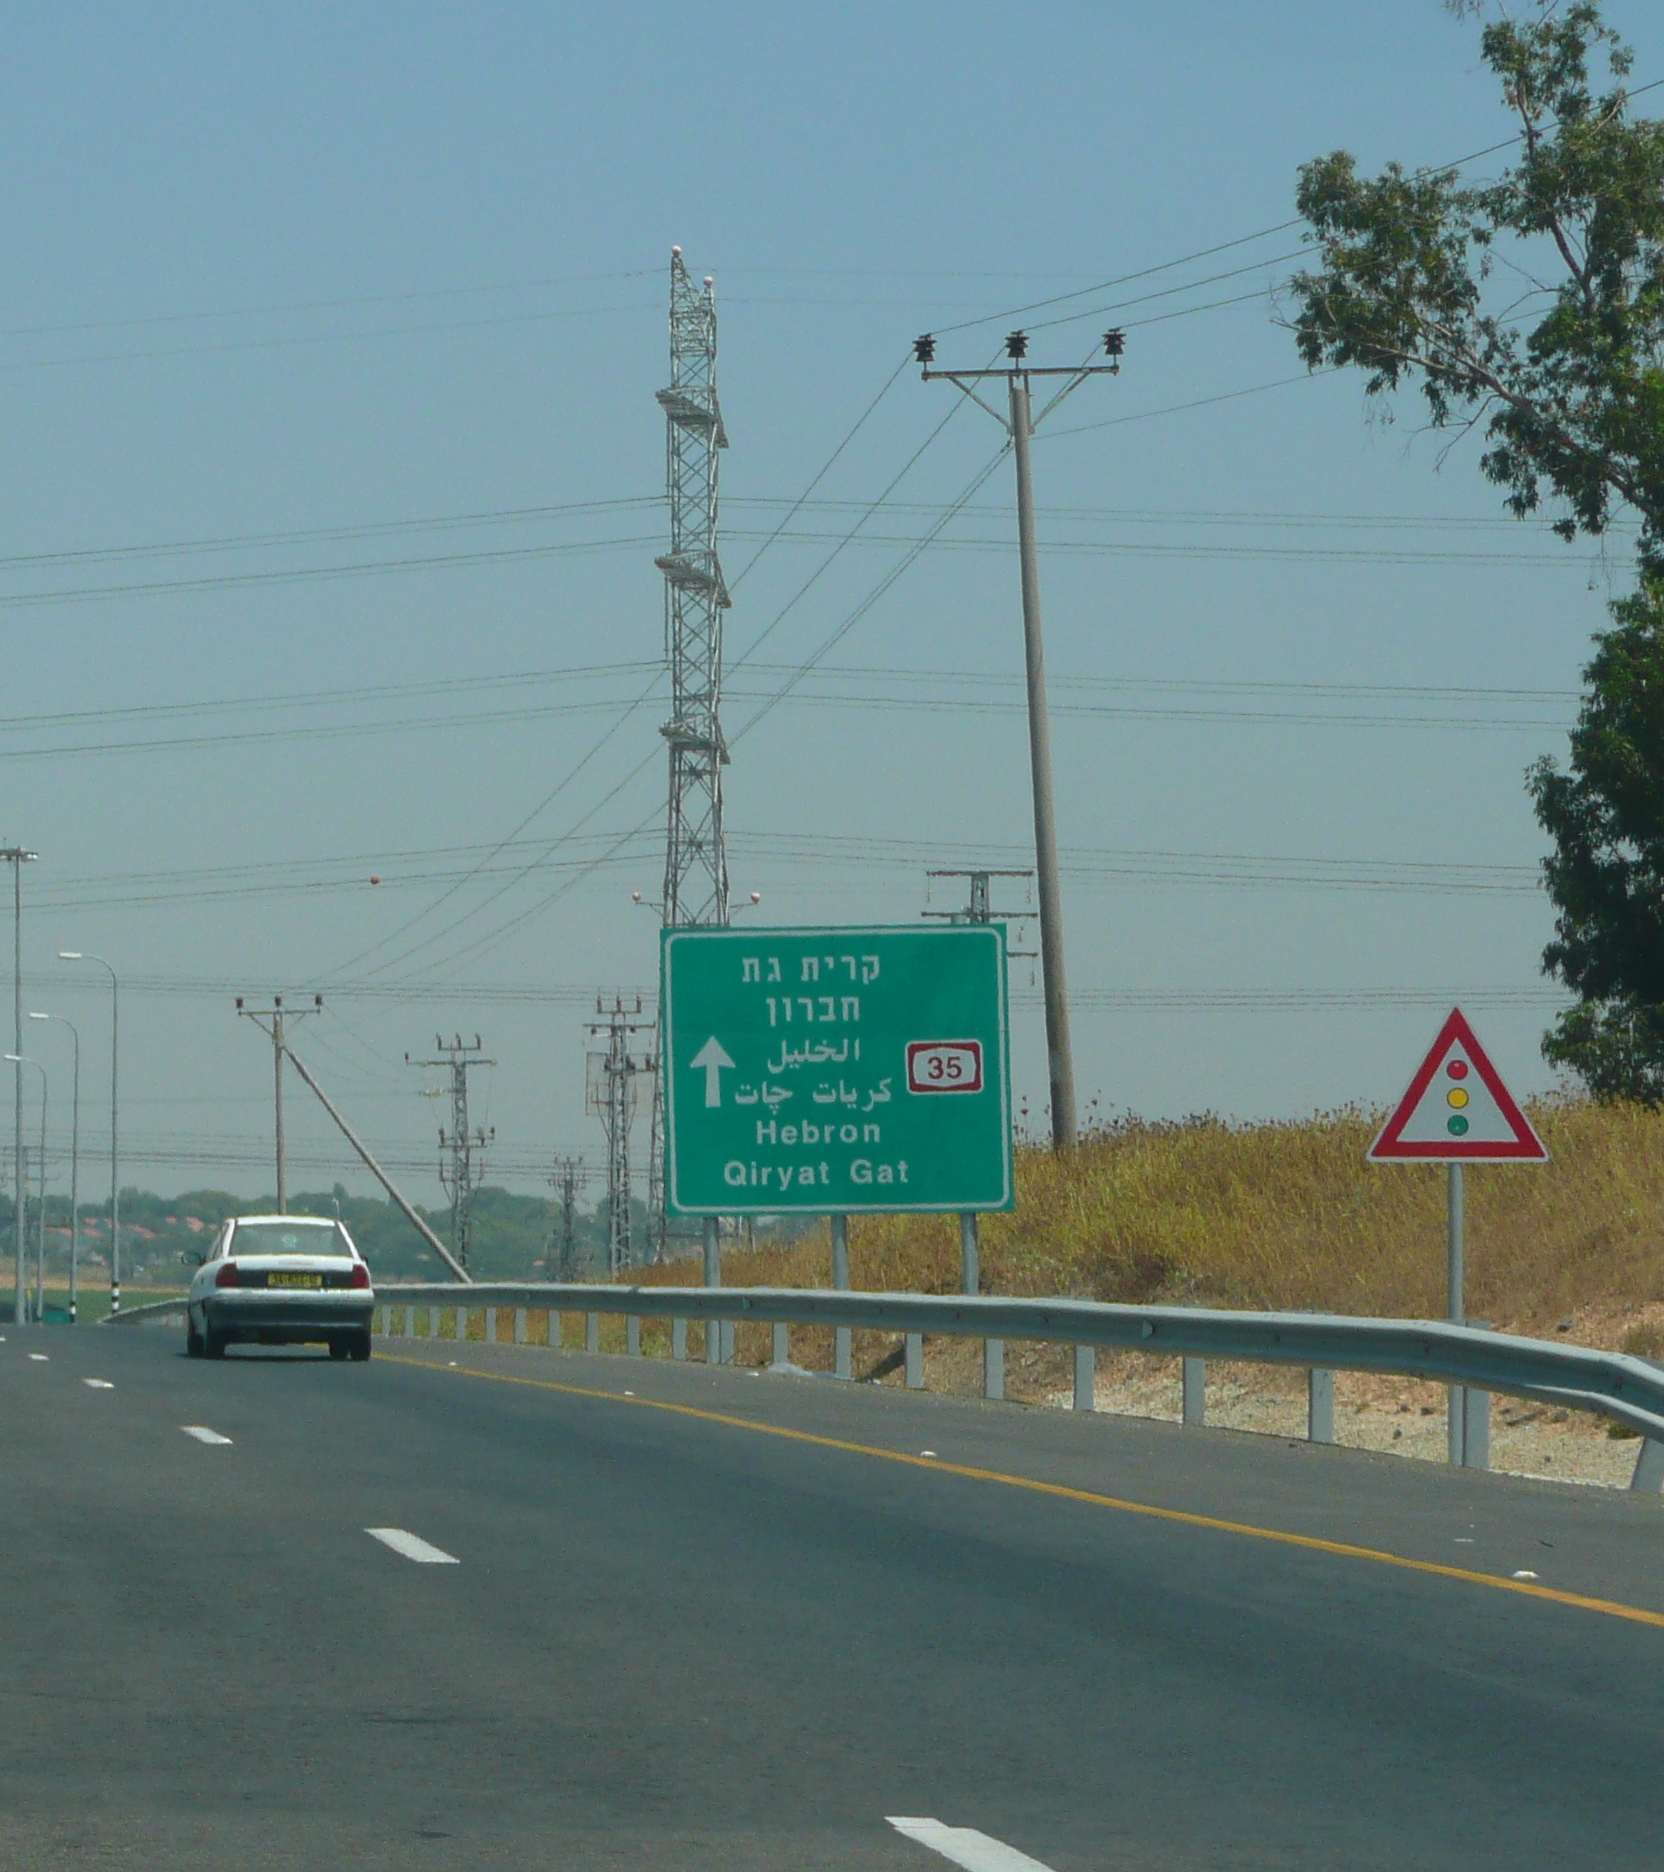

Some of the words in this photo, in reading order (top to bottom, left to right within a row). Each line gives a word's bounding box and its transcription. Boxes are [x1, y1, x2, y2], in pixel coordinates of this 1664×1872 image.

[742, 957, 781, 982] גת
[801, 955, 881, 984] קרית
[766, 996, 860, 1026] חברון
[767, 1038, 860, 1074] الخليل
[927, 1055, 963, 1080] 35
[812, 1078, 892, 1112] كريات
[756, 1119, 881, 1144] Hebron
[723, 1159, 829, 1191] Qiryat
[850, 1158, 909, 1184] Gat
